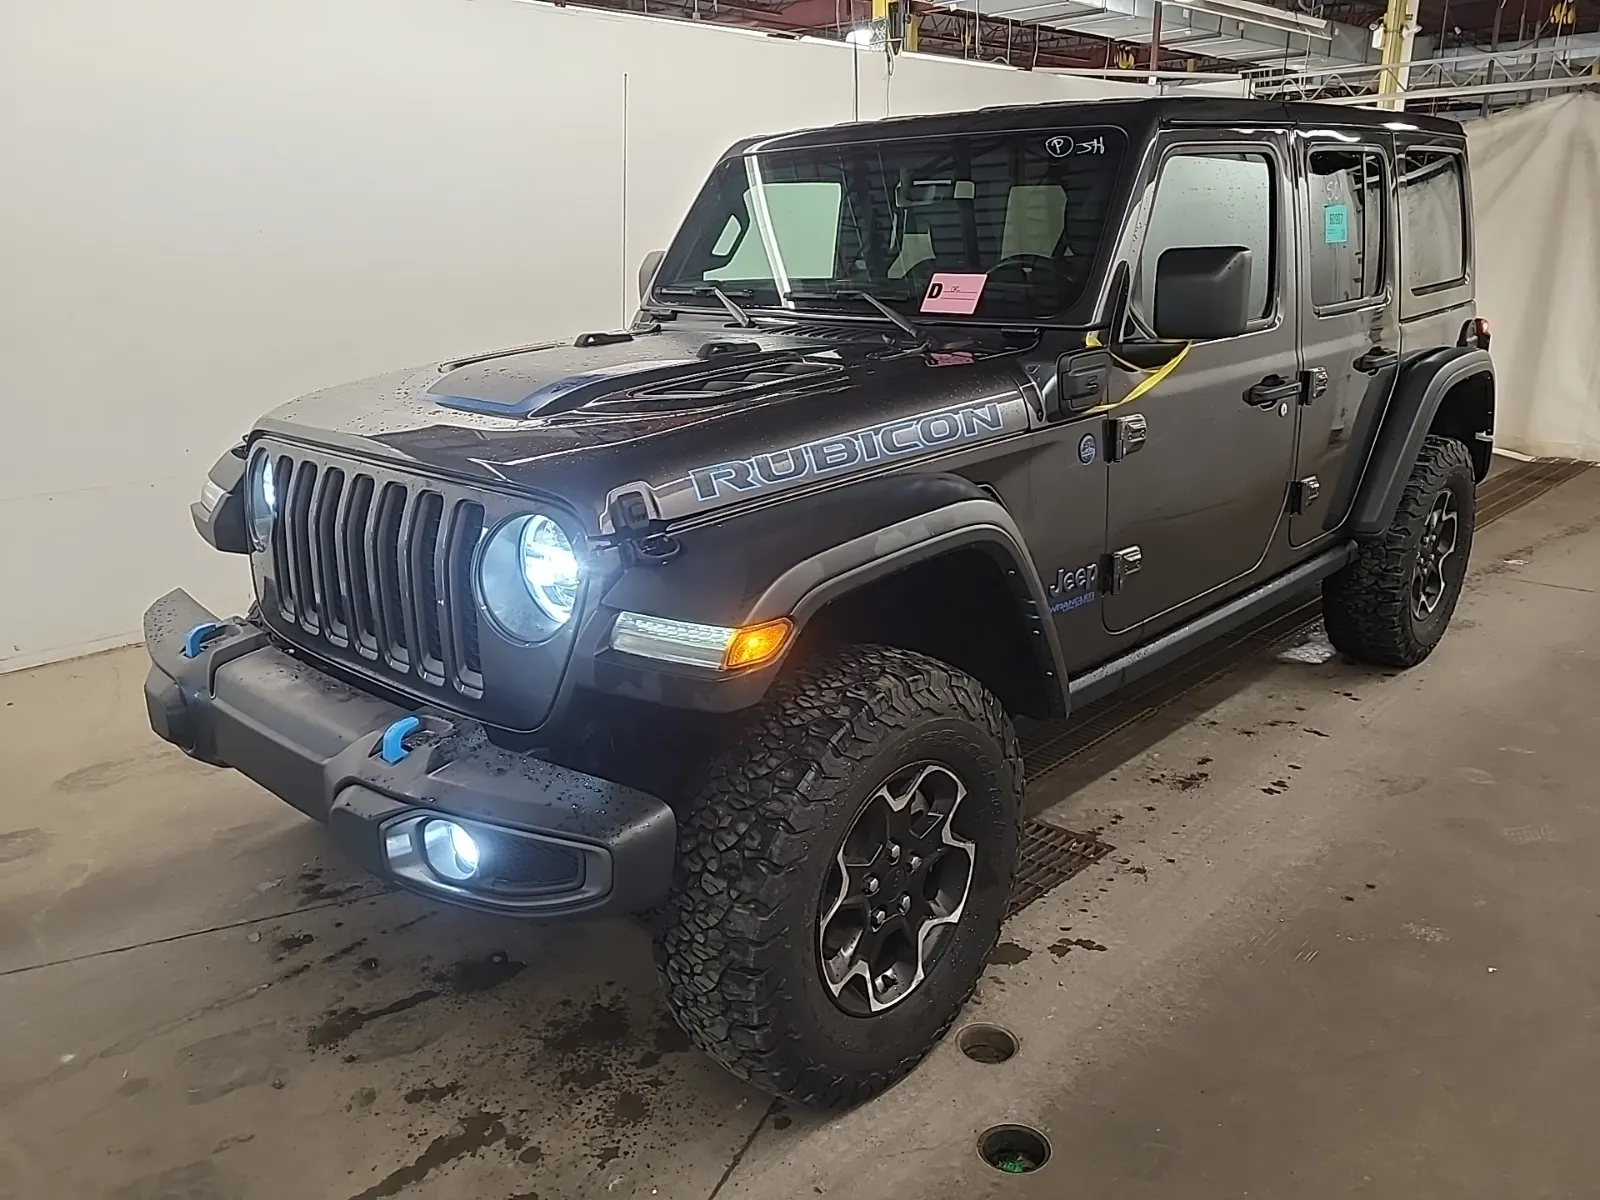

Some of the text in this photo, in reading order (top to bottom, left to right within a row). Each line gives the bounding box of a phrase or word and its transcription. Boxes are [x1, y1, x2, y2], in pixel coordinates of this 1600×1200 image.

[926, 282, 944, 299] D
[688, 402, 1004, 501] RUBICON
[1049, 563, 1098, 598] Jeep
